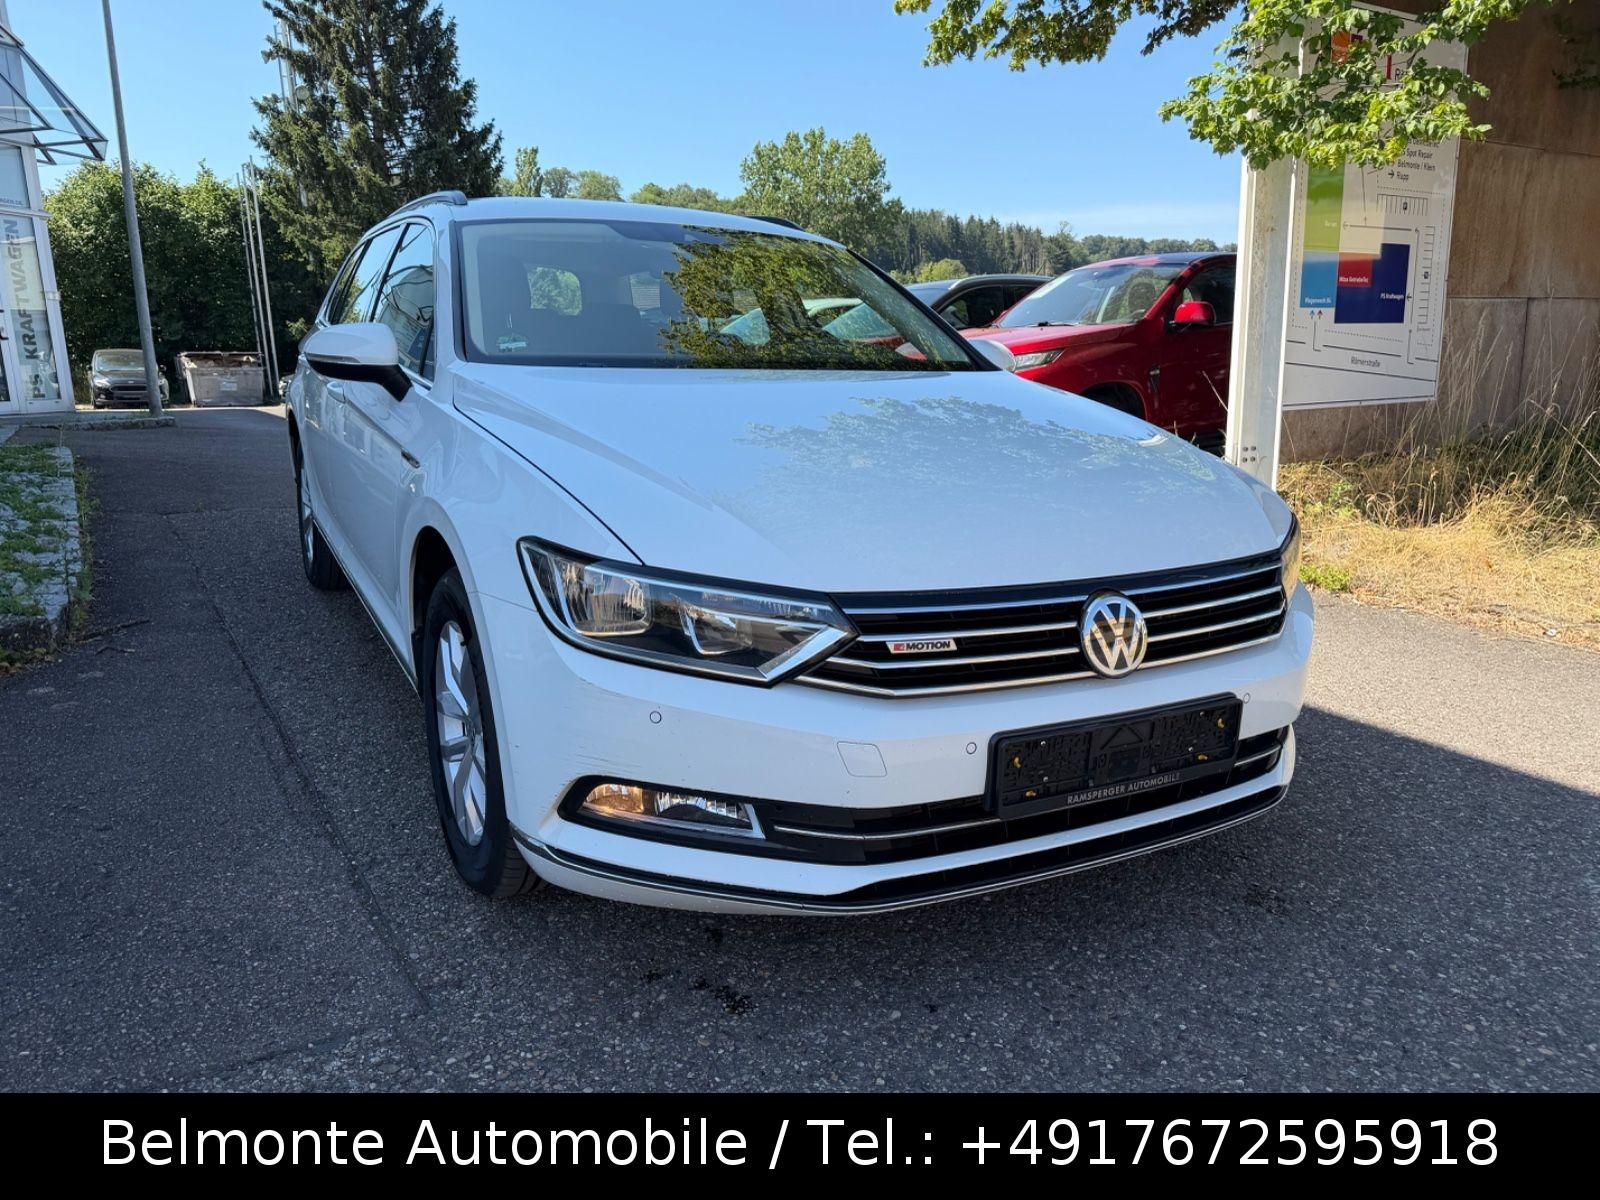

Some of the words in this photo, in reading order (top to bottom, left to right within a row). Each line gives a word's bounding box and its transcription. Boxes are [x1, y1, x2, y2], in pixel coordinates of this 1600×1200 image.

[1397, 159, 1420, 170] Belmonte
[3, 218, 39, 360] KRAFTWAGEN
[1351, 355, 1380, 368] Römerstraße
[29, 373, 46, 399] PS
[1082, 595, 1148, 676] VW
[1067, 784, 1126, 805] RAMSPERGER
[1127, 772, 1181, 792] AUTOMOBILE
